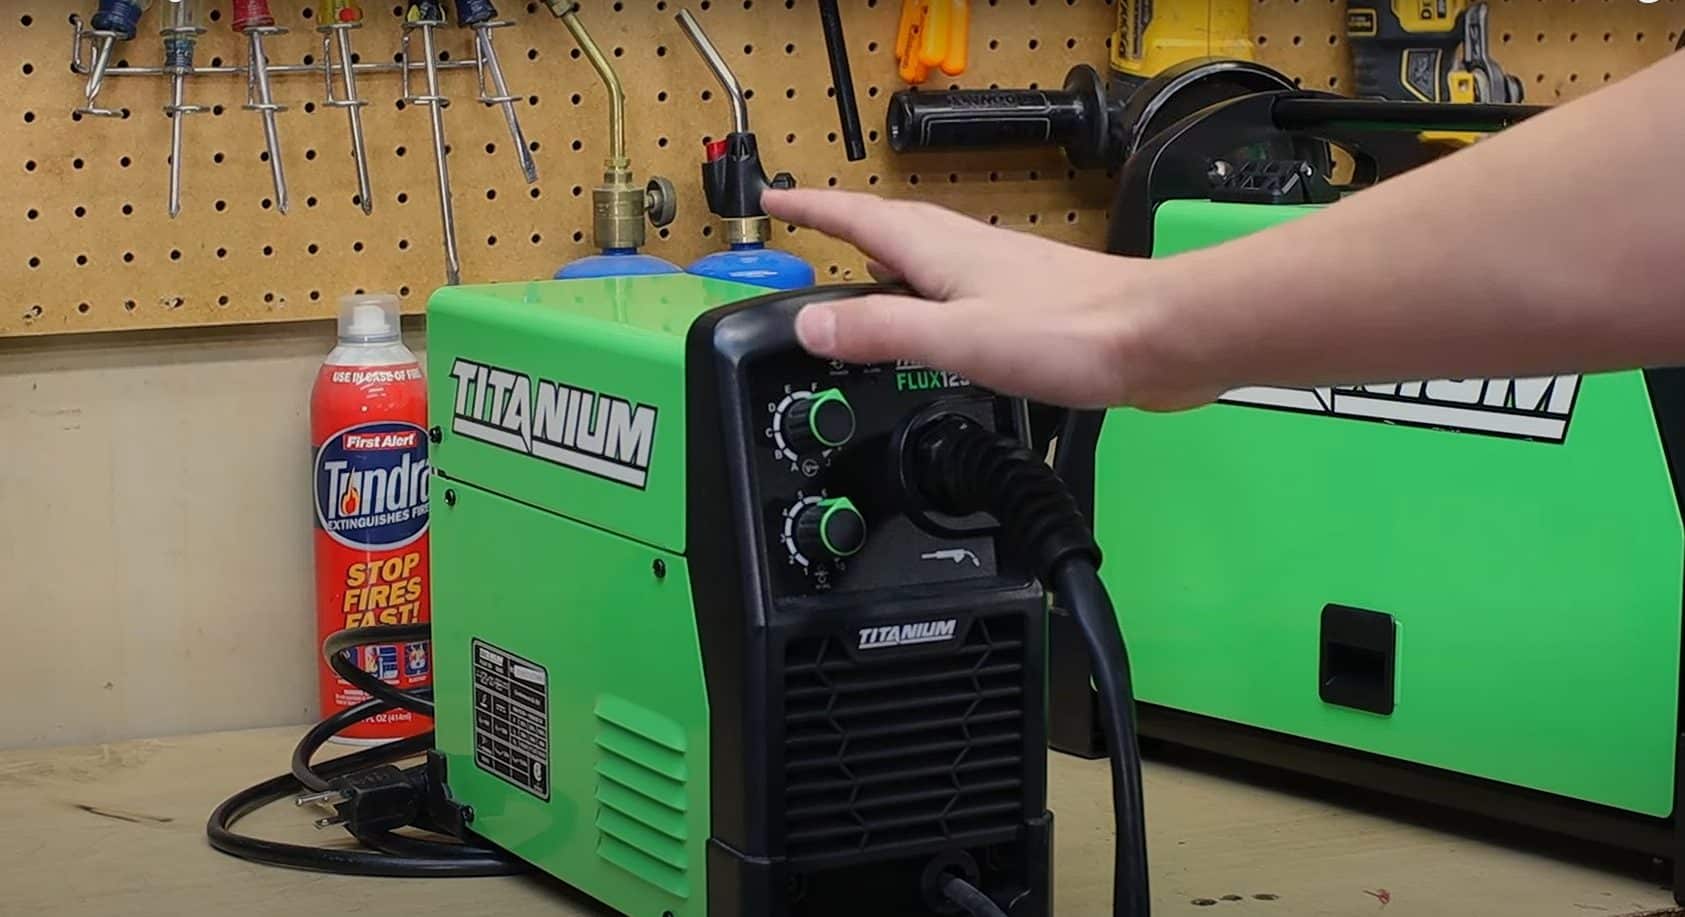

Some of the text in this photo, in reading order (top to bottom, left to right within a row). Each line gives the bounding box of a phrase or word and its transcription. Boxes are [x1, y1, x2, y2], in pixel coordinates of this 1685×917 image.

[450, 358, 657, 470] TITANIUM
[346, 433, 416, 449] First Alert
[327, 509, 410, 531] EXTINGUISHES
[346, 552, 420, 587] STOP
[343, 576, 422, 612] FIRES
[345, 601, 420, 629] FAST!
[859, 620, 956, 646] TITANIUM
